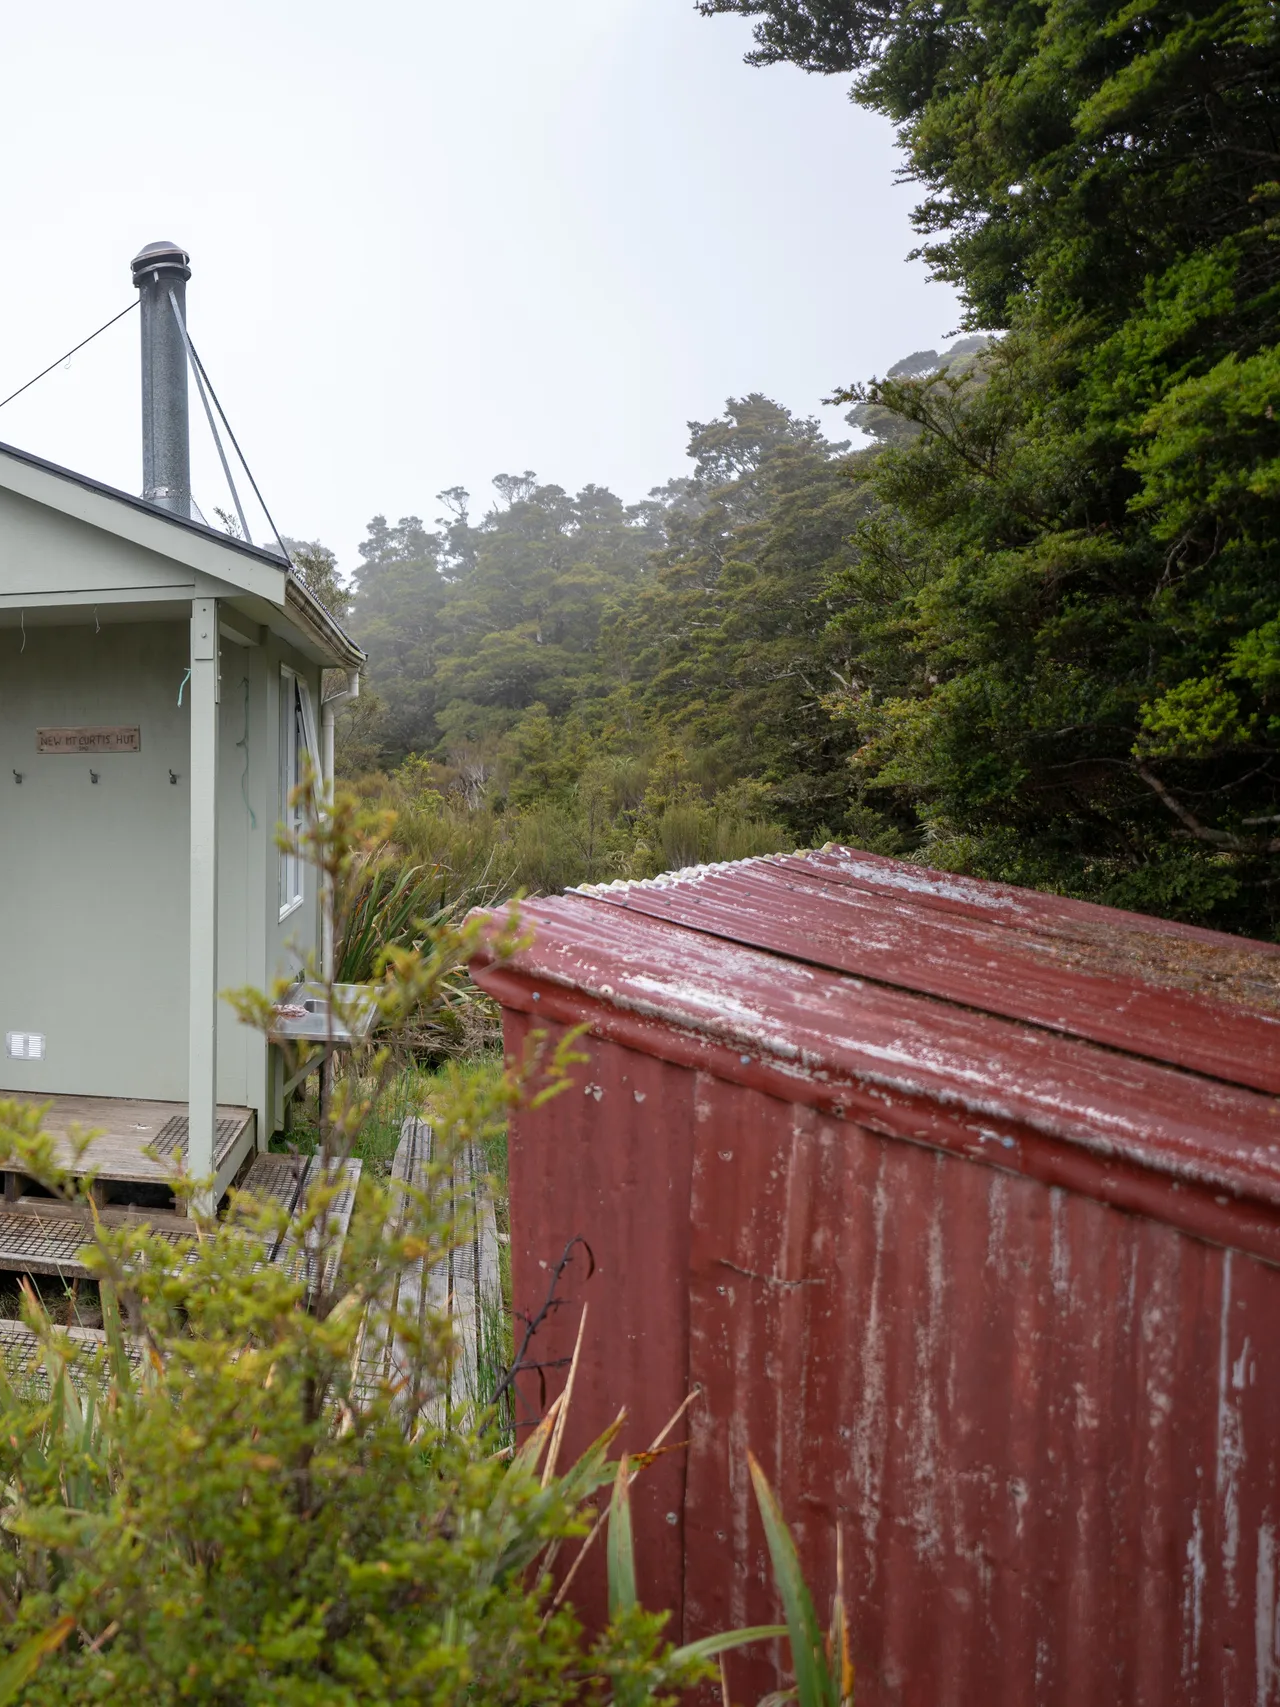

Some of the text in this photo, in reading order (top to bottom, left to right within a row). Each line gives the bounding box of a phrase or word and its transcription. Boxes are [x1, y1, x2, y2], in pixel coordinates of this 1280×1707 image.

[40, 734, 135, 746] NEW MT CURTIS HUT
